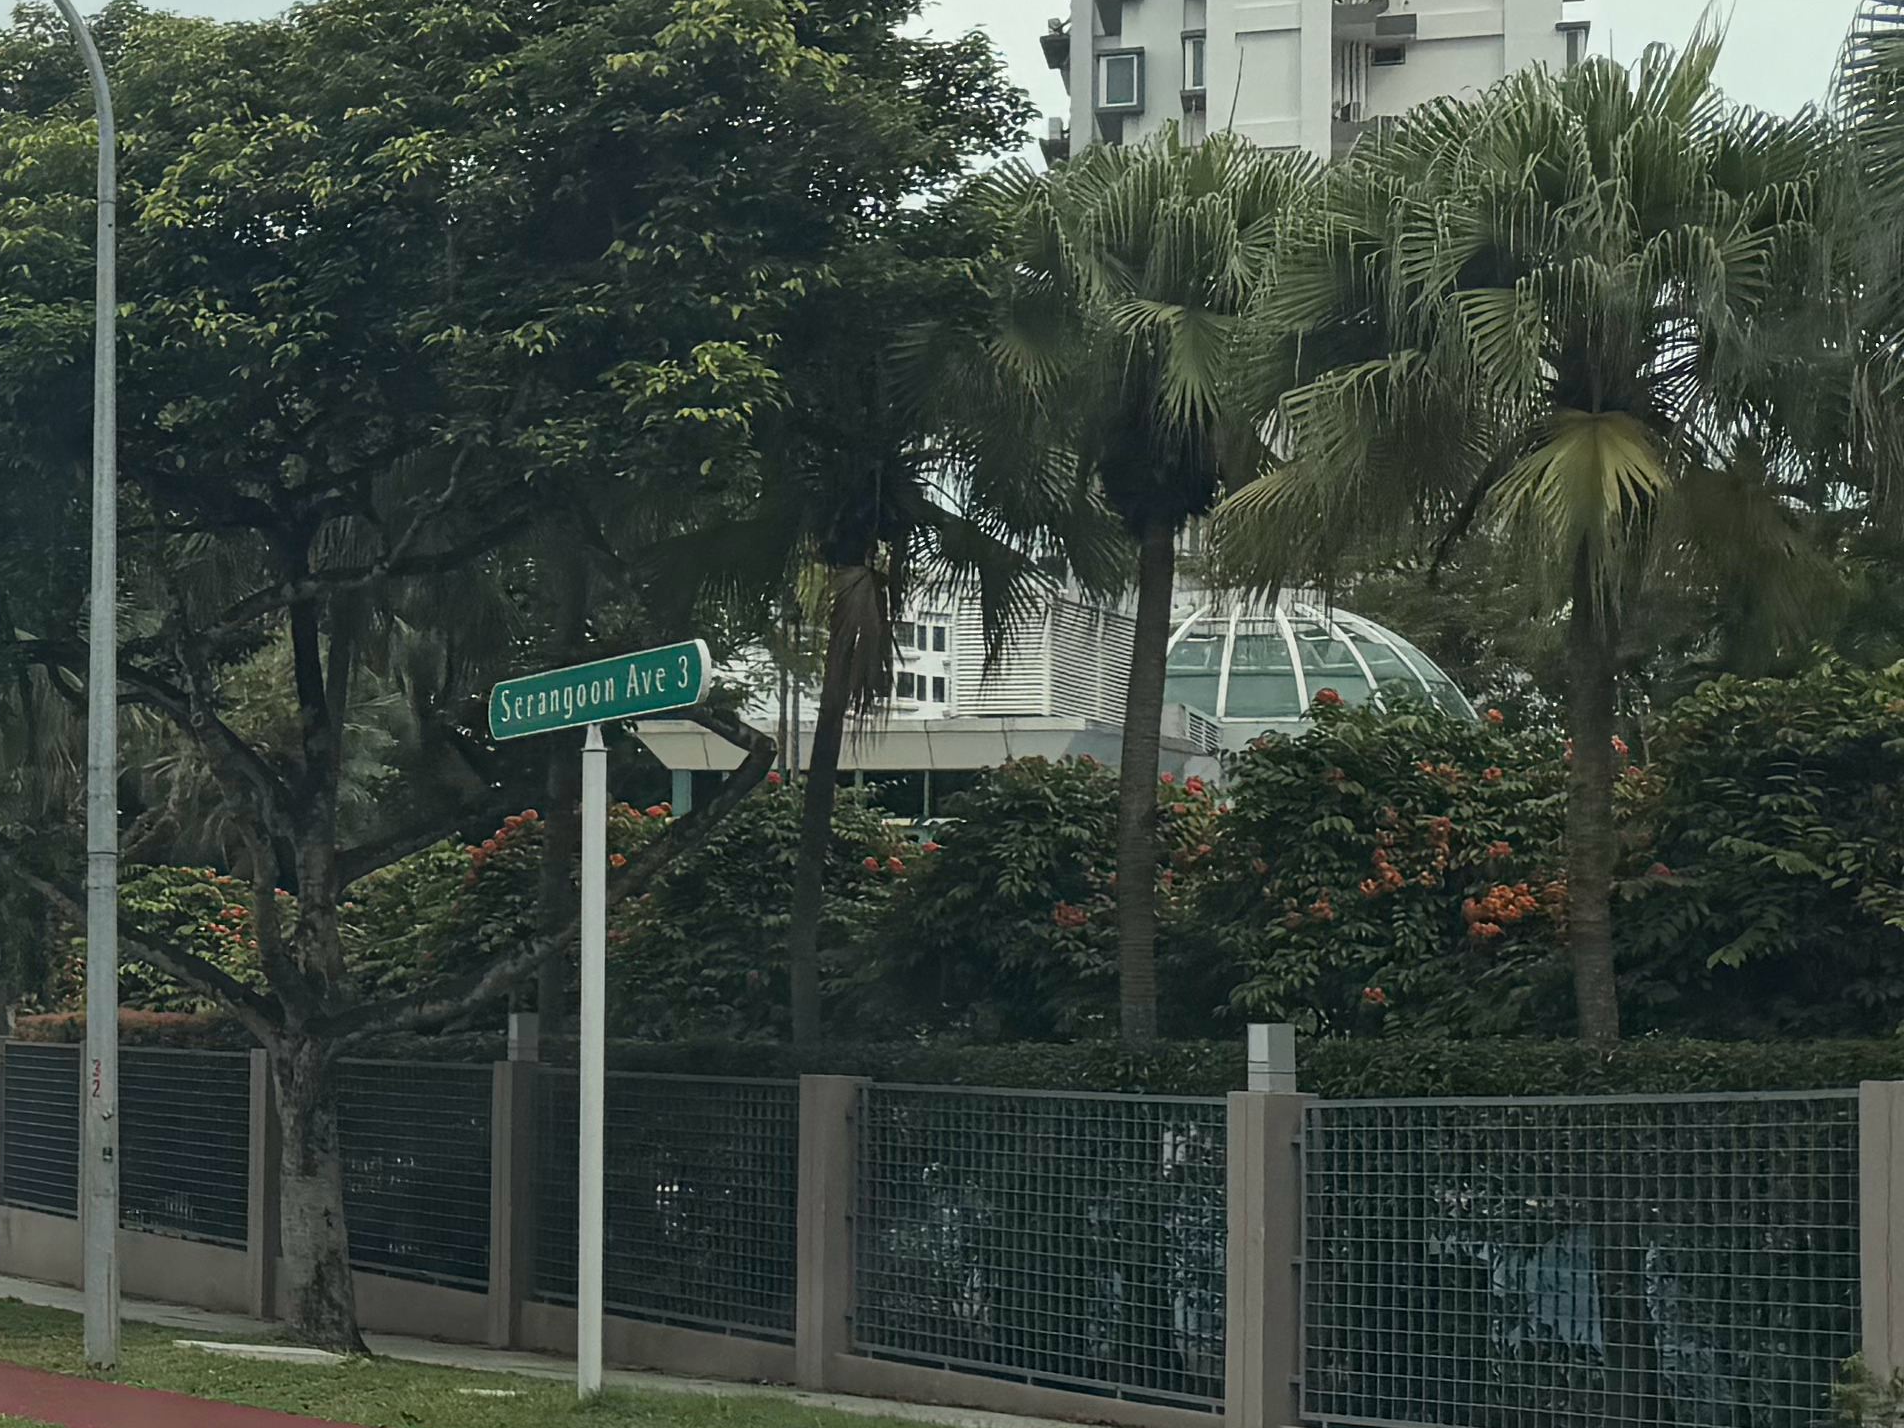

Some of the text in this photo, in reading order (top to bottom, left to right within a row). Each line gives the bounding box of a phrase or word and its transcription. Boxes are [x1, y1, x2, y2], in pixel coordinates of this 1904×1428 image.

[501, 655, 688, 722] Serangoon Ave 3
